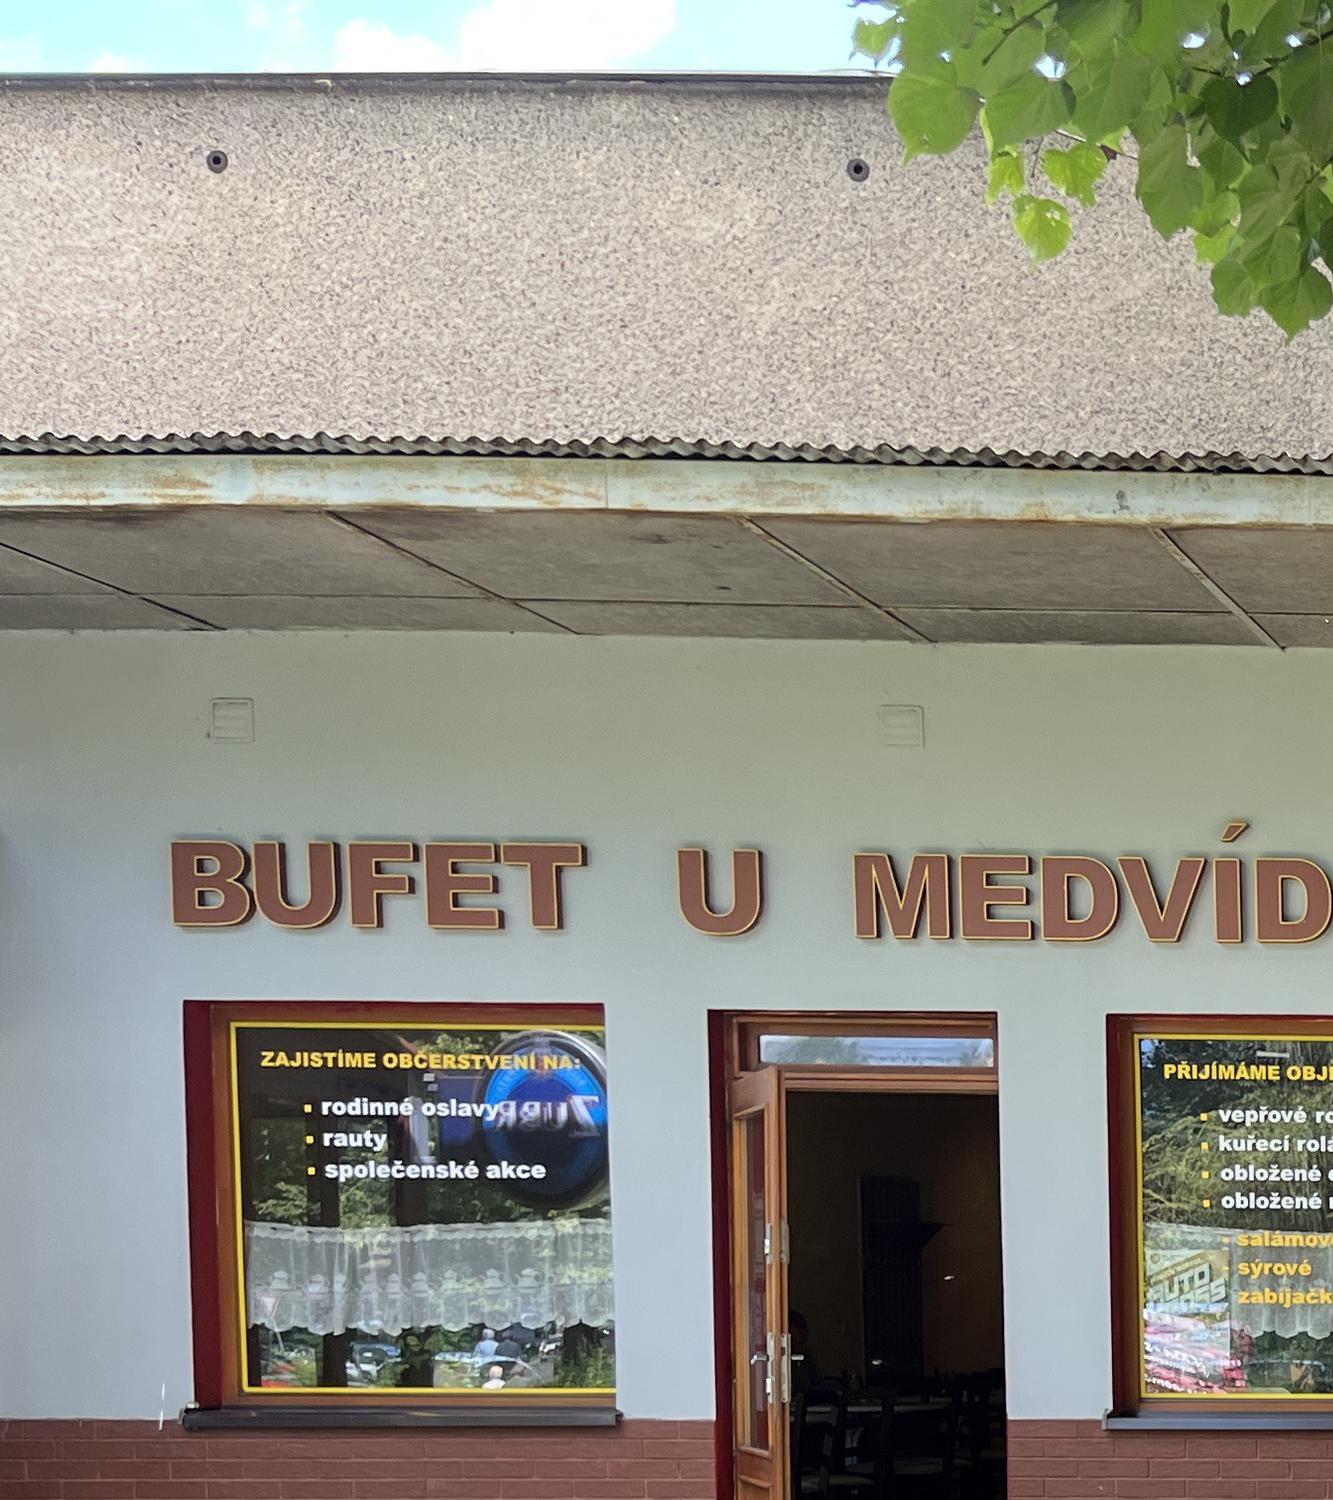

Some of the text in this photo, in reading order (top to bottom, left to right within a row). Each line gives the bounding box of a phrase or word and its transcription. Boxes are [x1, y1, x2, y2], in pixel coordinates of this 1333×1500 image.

[170, 840, 587, 931] BUFET
[676, 847, 763, 937] U
[261, 1050, 581, 1070] ZAJISTÍME OBČERSTVENÍ NA:
[1163, 1061, 1281, 1081] PŘIJÍMÁME
[321, 1098, 499, 1122] rodinné oslavy
[1218, 1106, 1307, 1127] vepřové
[322, 1130, 388, 1152] rauty
[1218, 1135, 1290, 1152] kuřecí
[325, 1160, 546, 1183] společenské akce
[1220, 1164, 1322, 1182] obložené
[1221, 1192, 1323, 1210] obložené
[1238, 1259, 1312, 1279] sýrové
